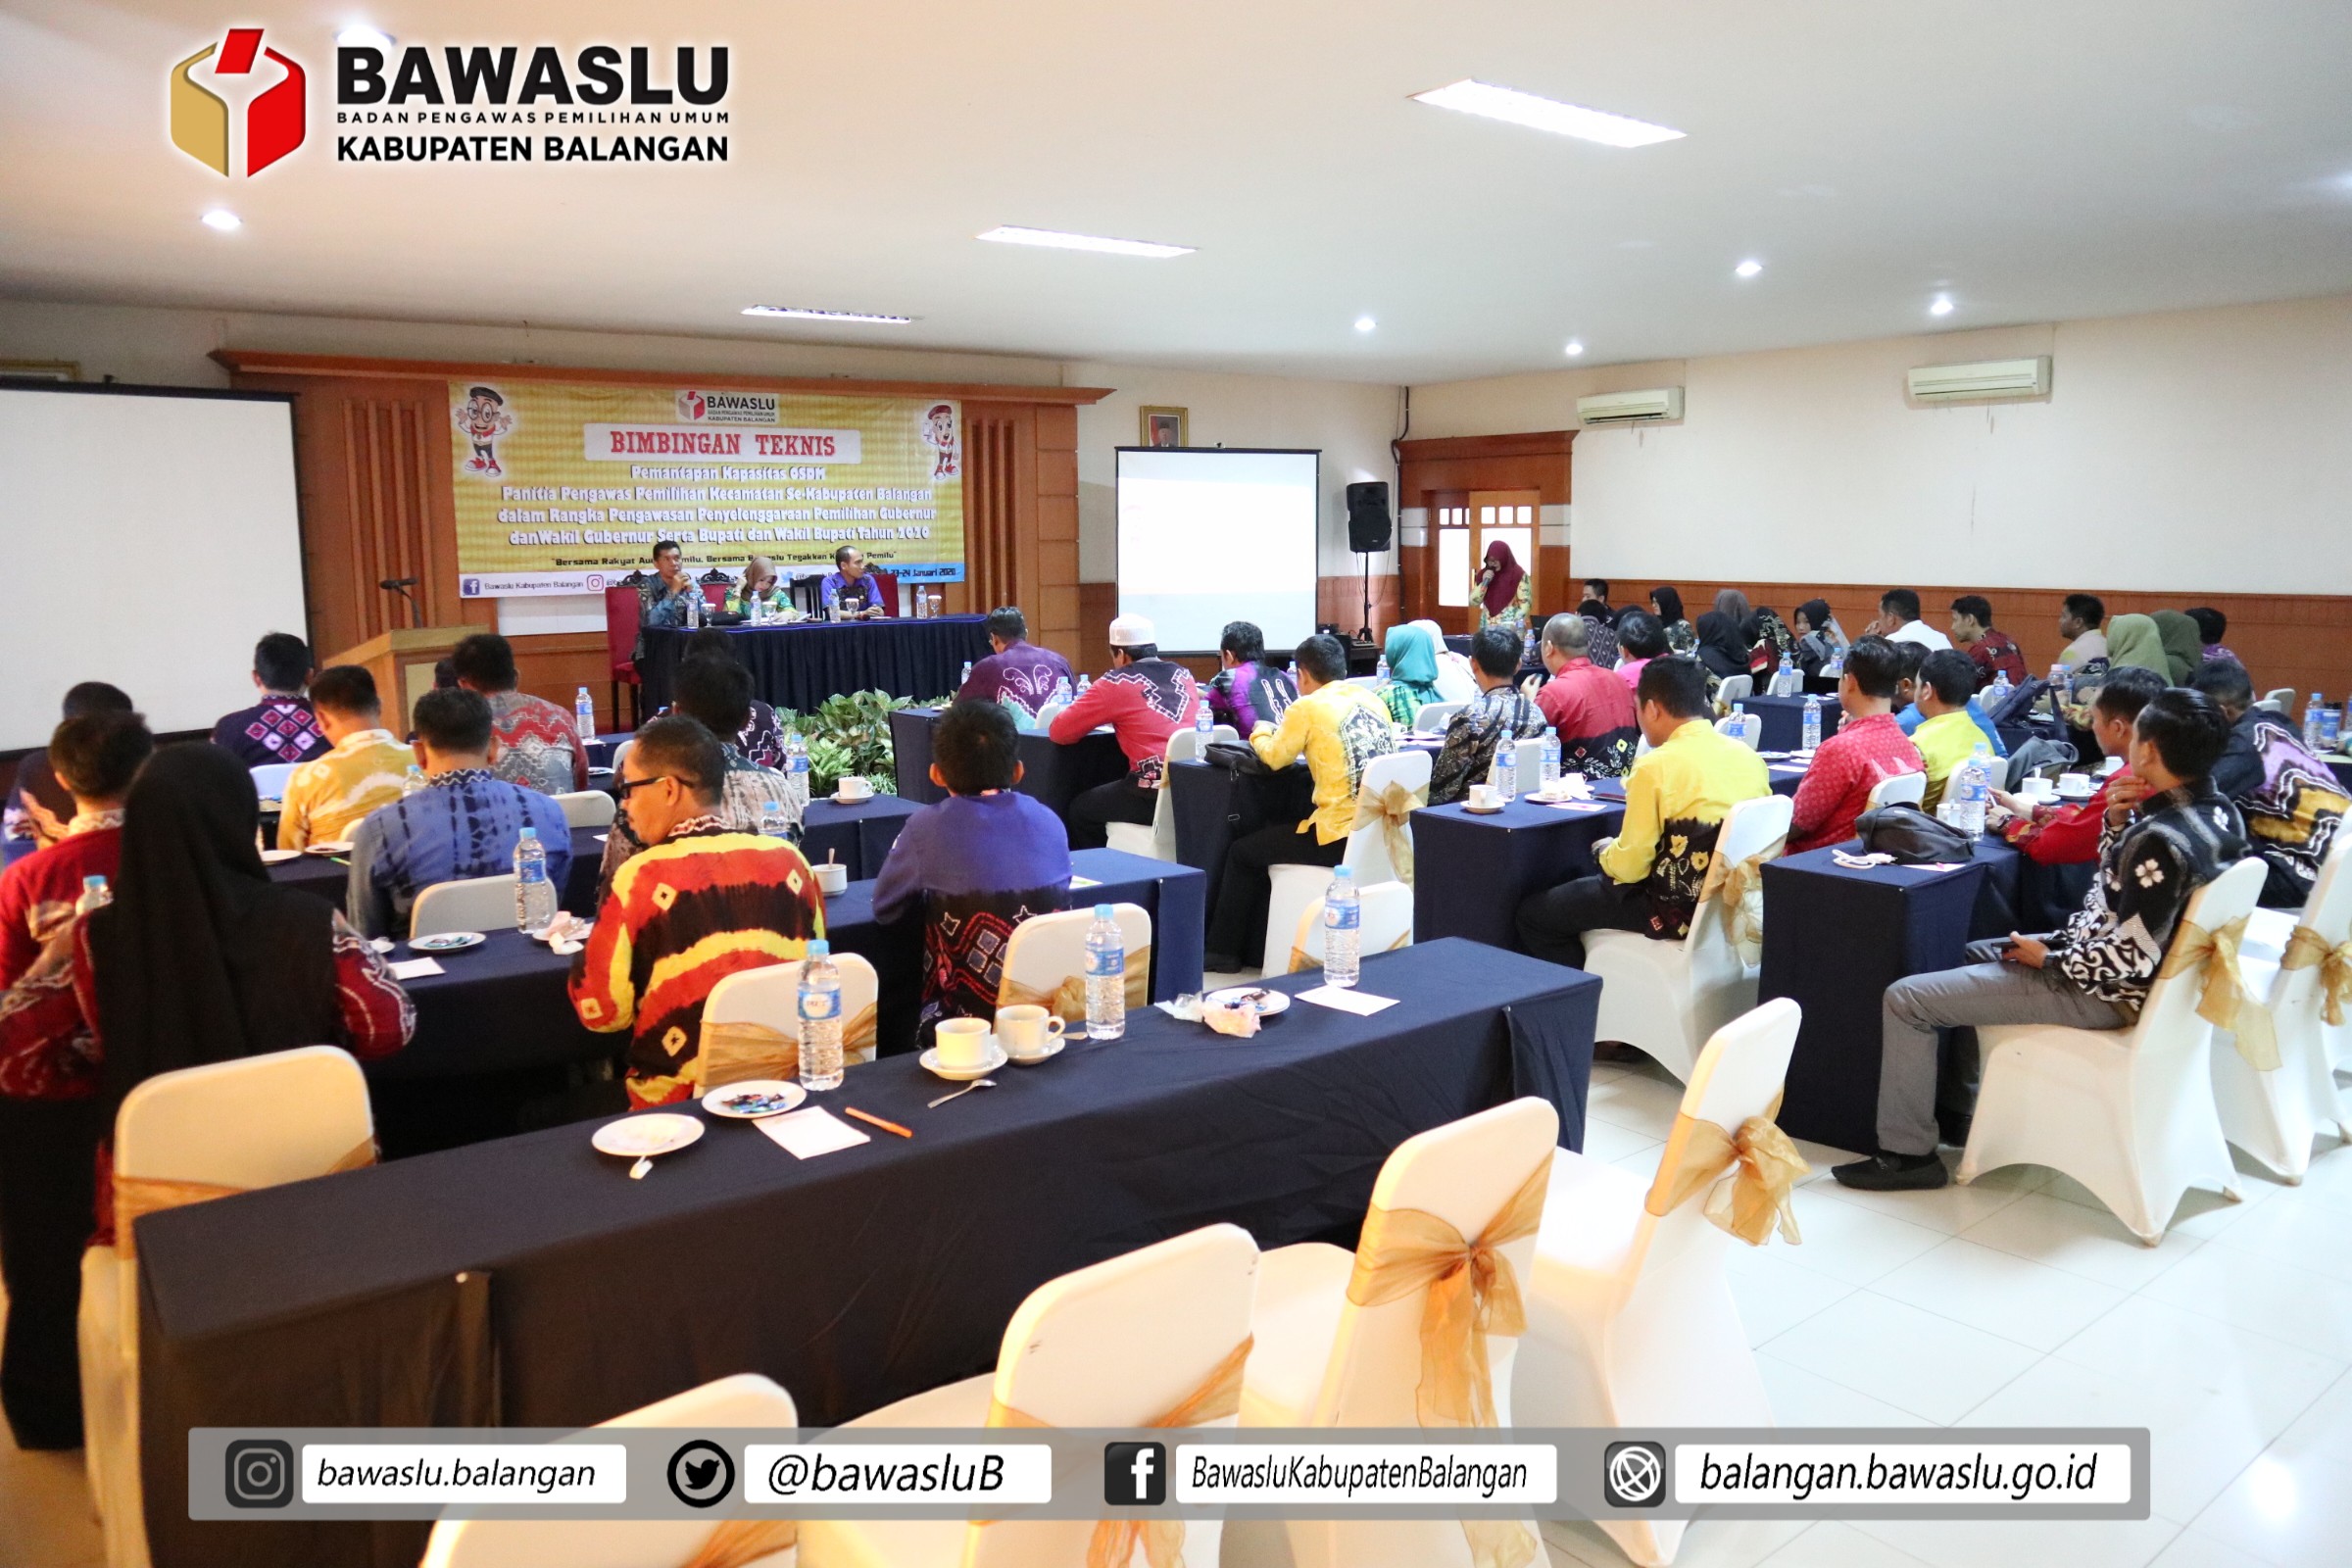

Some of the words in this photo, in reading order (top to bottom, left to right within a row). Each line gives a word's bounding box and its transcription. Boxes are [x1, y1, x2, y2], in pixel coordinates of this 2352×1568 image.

[707, 396, 775, 410] BAWASLU
[611, 430, 741, 456] BIMBINGAN
[755, 434, 836, 457] TEKNIS
[630, 465, 718, 482] Pemantapan
[721, 466, 785, 482] Kapasitas
[502, 486, 557, 501] Panitia
[561, 486, 631, 504] Pengawas
[635, 486, 706, 501] Pemilihan
[709, 487, 783, 501] Kecamatan
[786, 487, 872, 503] Se-Kabupaten
[876, 487, 931, 503] Balangan
[498, 508, 545, 523] dalam
[549, 508, 605, 524] Rangka
[608, 508, 694, 524] Pengawasan
[697, 508, 809, 523] Penyelenggaraan
[812, 507, 876, 521] Pemilihan
[879, 507, 936, 521] Gubernur
[583, 528, 654, 544] Gubernur
[657, 528, 694, 543] Serta
[698, 527, 744, 544] Bupati
[747, 527, 771, 541] dan
[773, 526, 810, 542] Wakil
[812, 526, 856, 543] Bupati
[857, 526, 894, 540] Tahun
[896, 525, 930, 539] 2020
[602, 557, 635, 566] Rakyat
[787, 554, 827, 563] Tegakkan
[515, 581, 552, 590] Kabupaten
[554, 580, 583, 589] Balangan
